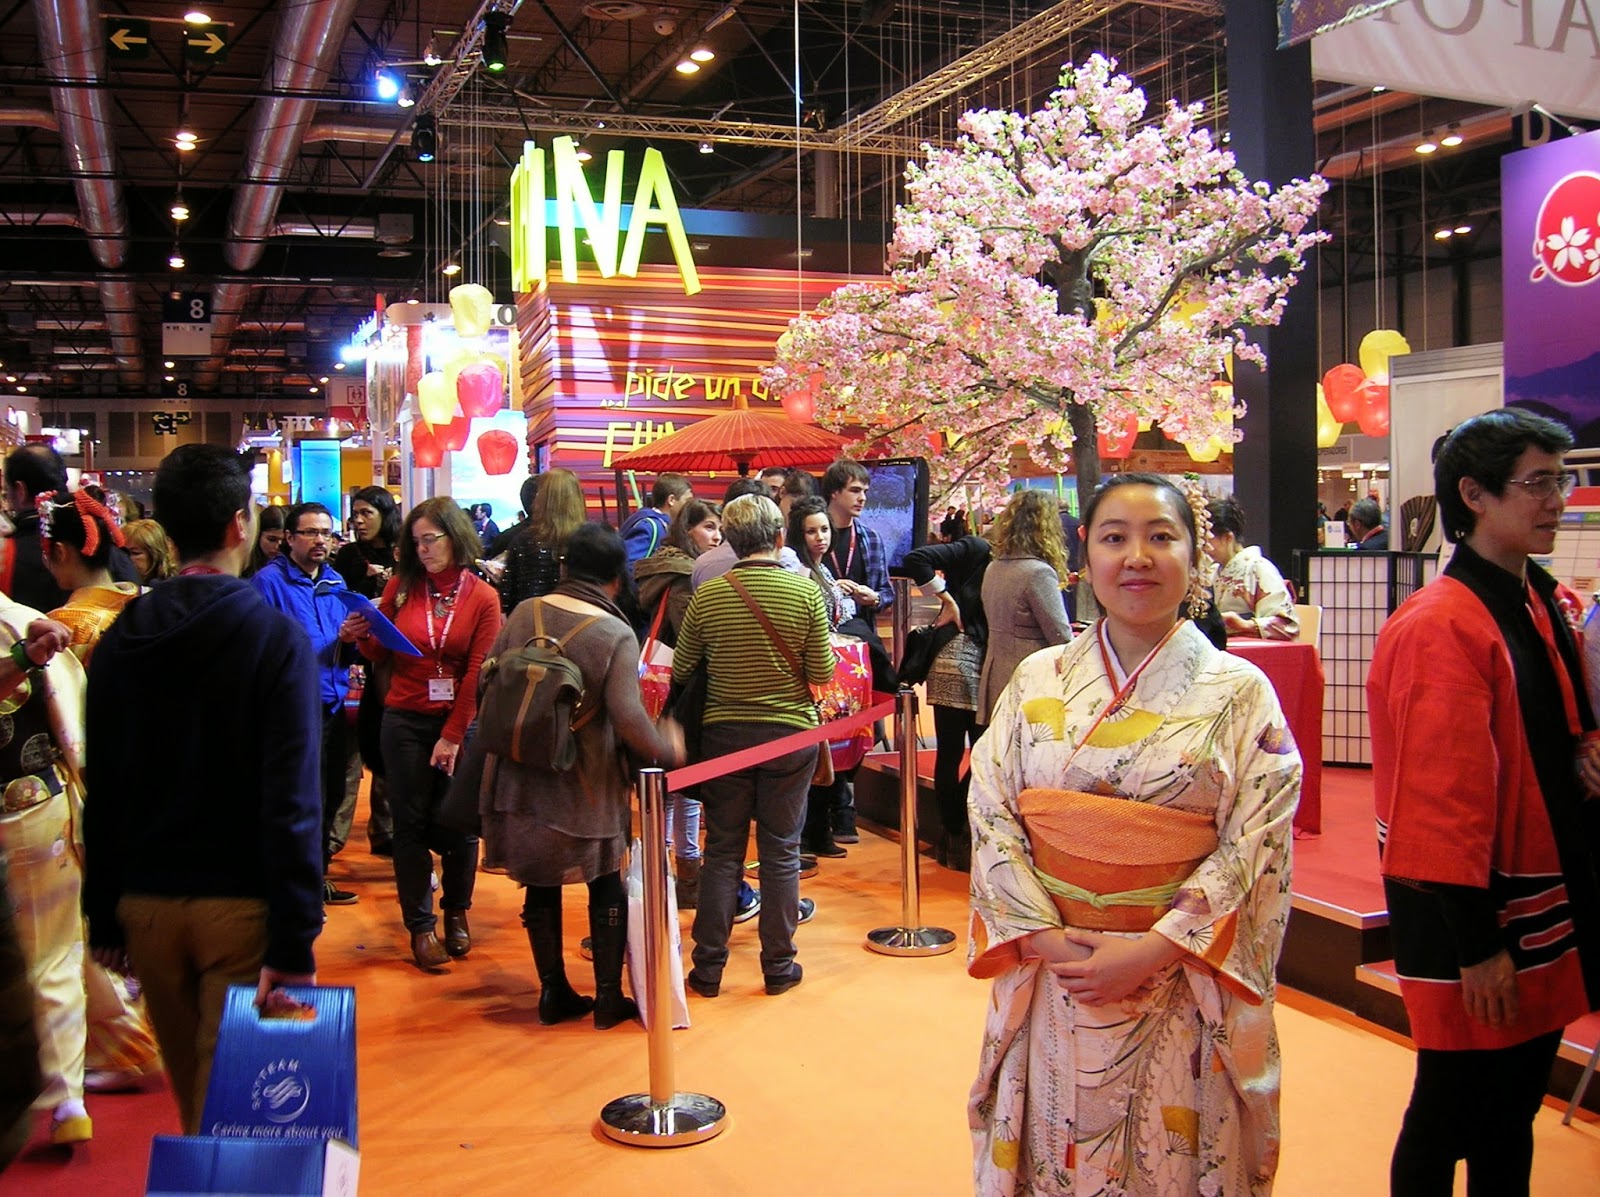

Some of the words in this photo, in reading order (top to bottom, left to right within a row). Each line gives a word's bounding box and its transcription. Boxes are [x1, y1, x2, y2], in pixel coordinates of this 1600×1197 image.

[190, 299, 205, 319] 8
[178, 383, 188, 396] 8
[705, 376, 741, 400] un
[211, 1120, 251, 1138] Caring
[252, 1126, 282, 1138] more
[284, 1123, 319, 1139] about
[321, 1126, 344, 1141] you
